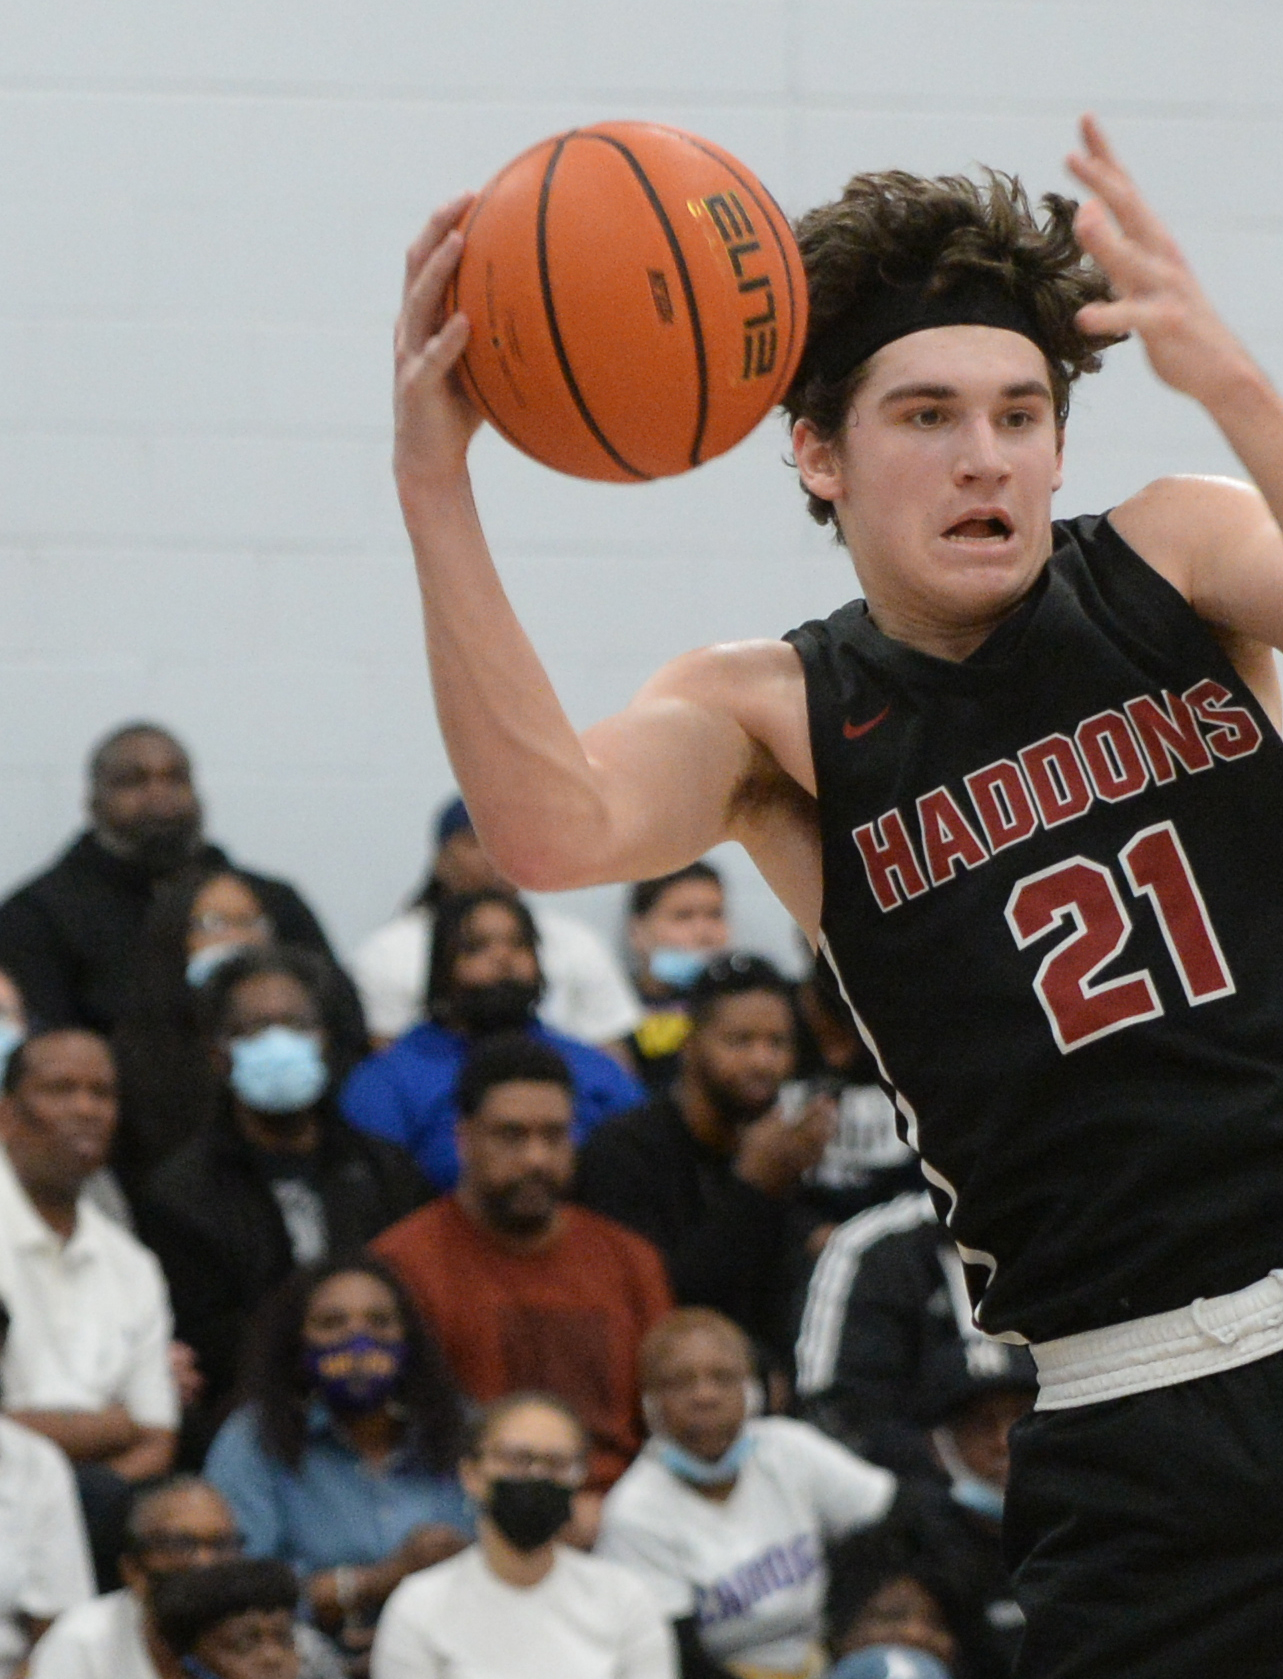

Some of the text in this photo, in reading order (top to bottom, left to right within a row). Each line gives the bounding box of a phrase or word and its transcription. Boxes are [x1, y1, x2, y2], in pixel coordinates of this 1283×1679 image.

[703, 190, 778, 382] ELITE
[852, 678, 1263, 913] HADDONS
[1004, 820, 1236, 1055] 21
